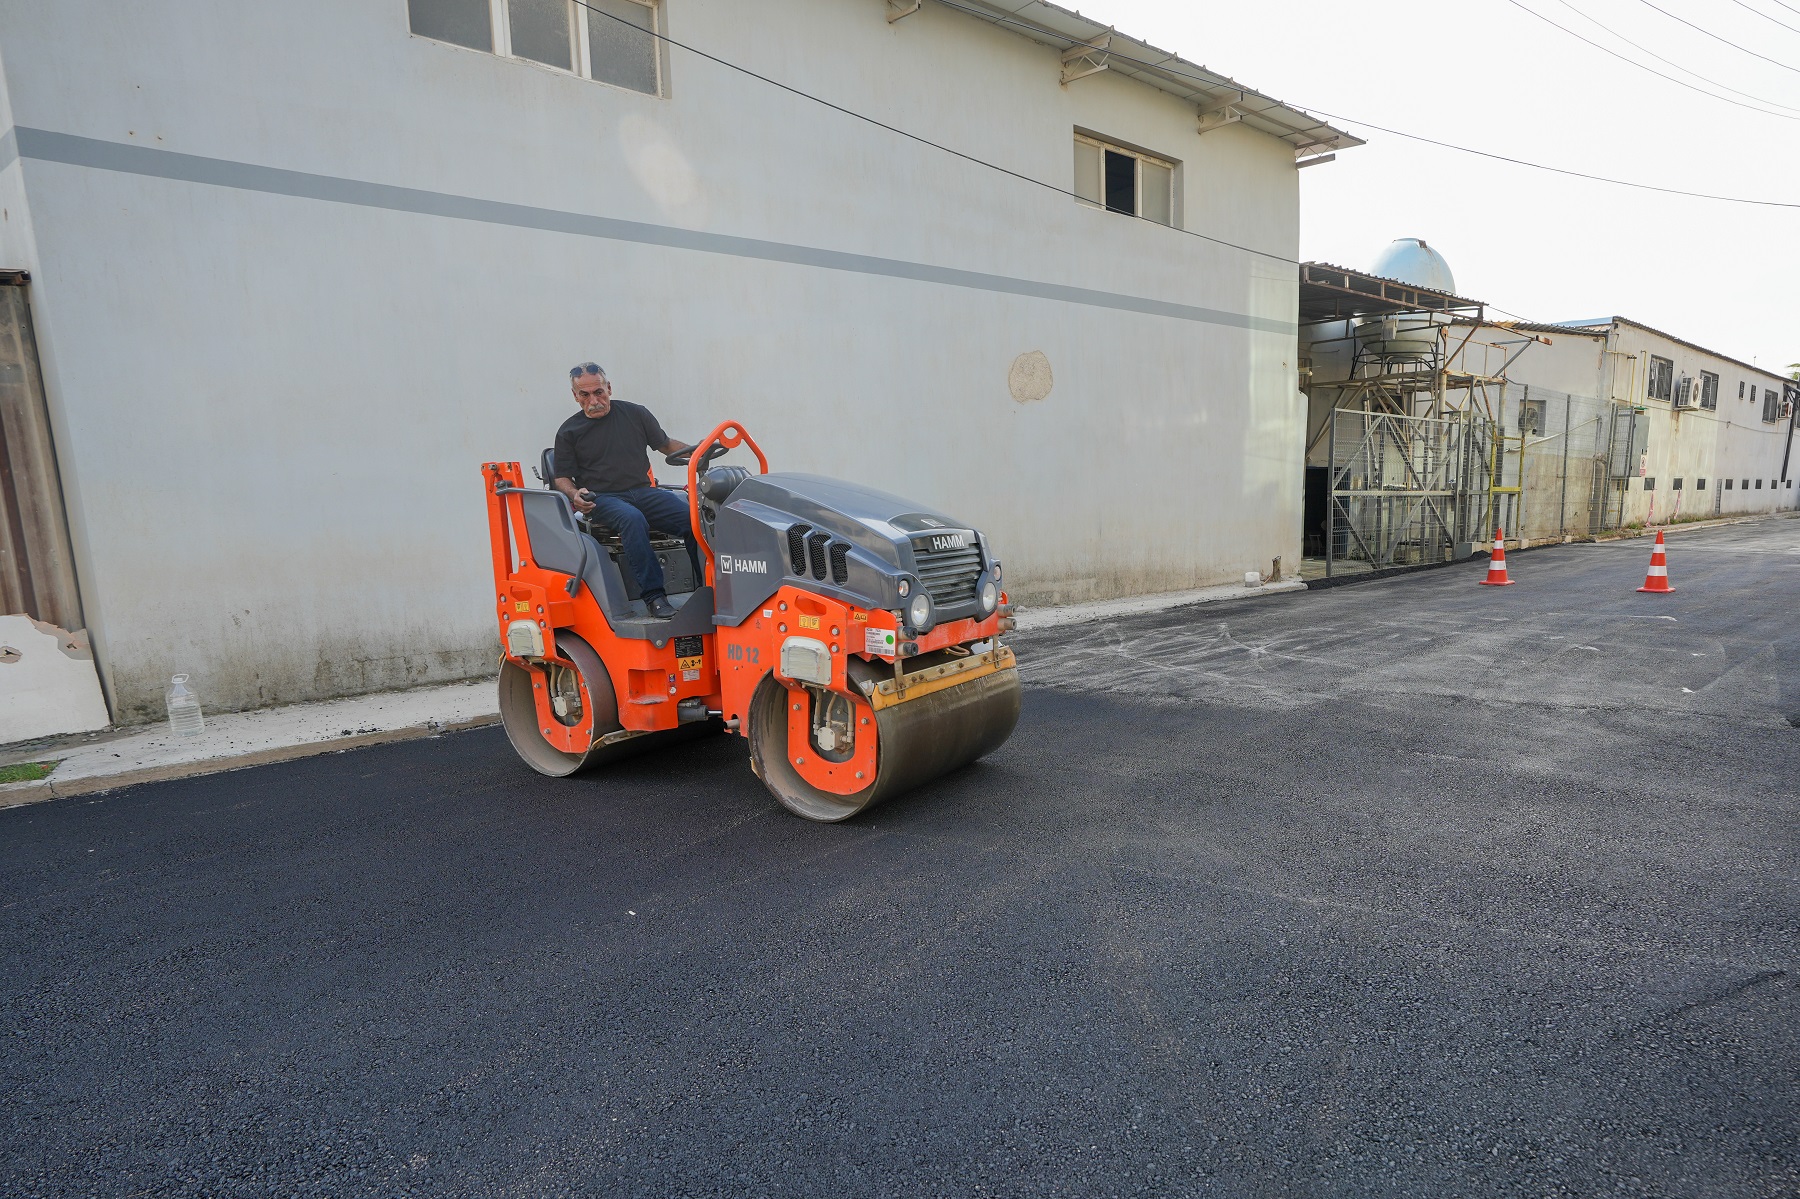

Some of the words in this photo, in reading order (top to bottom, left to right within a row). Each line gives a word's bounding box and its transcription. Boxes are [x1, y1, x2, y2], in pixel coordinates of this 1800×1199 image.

[932, 535, 965, 550] HAMM
[734, 559, 767, 574] HAMM
[727, 644, 743, 661] HD
[746, 646, 760, 664] 12
